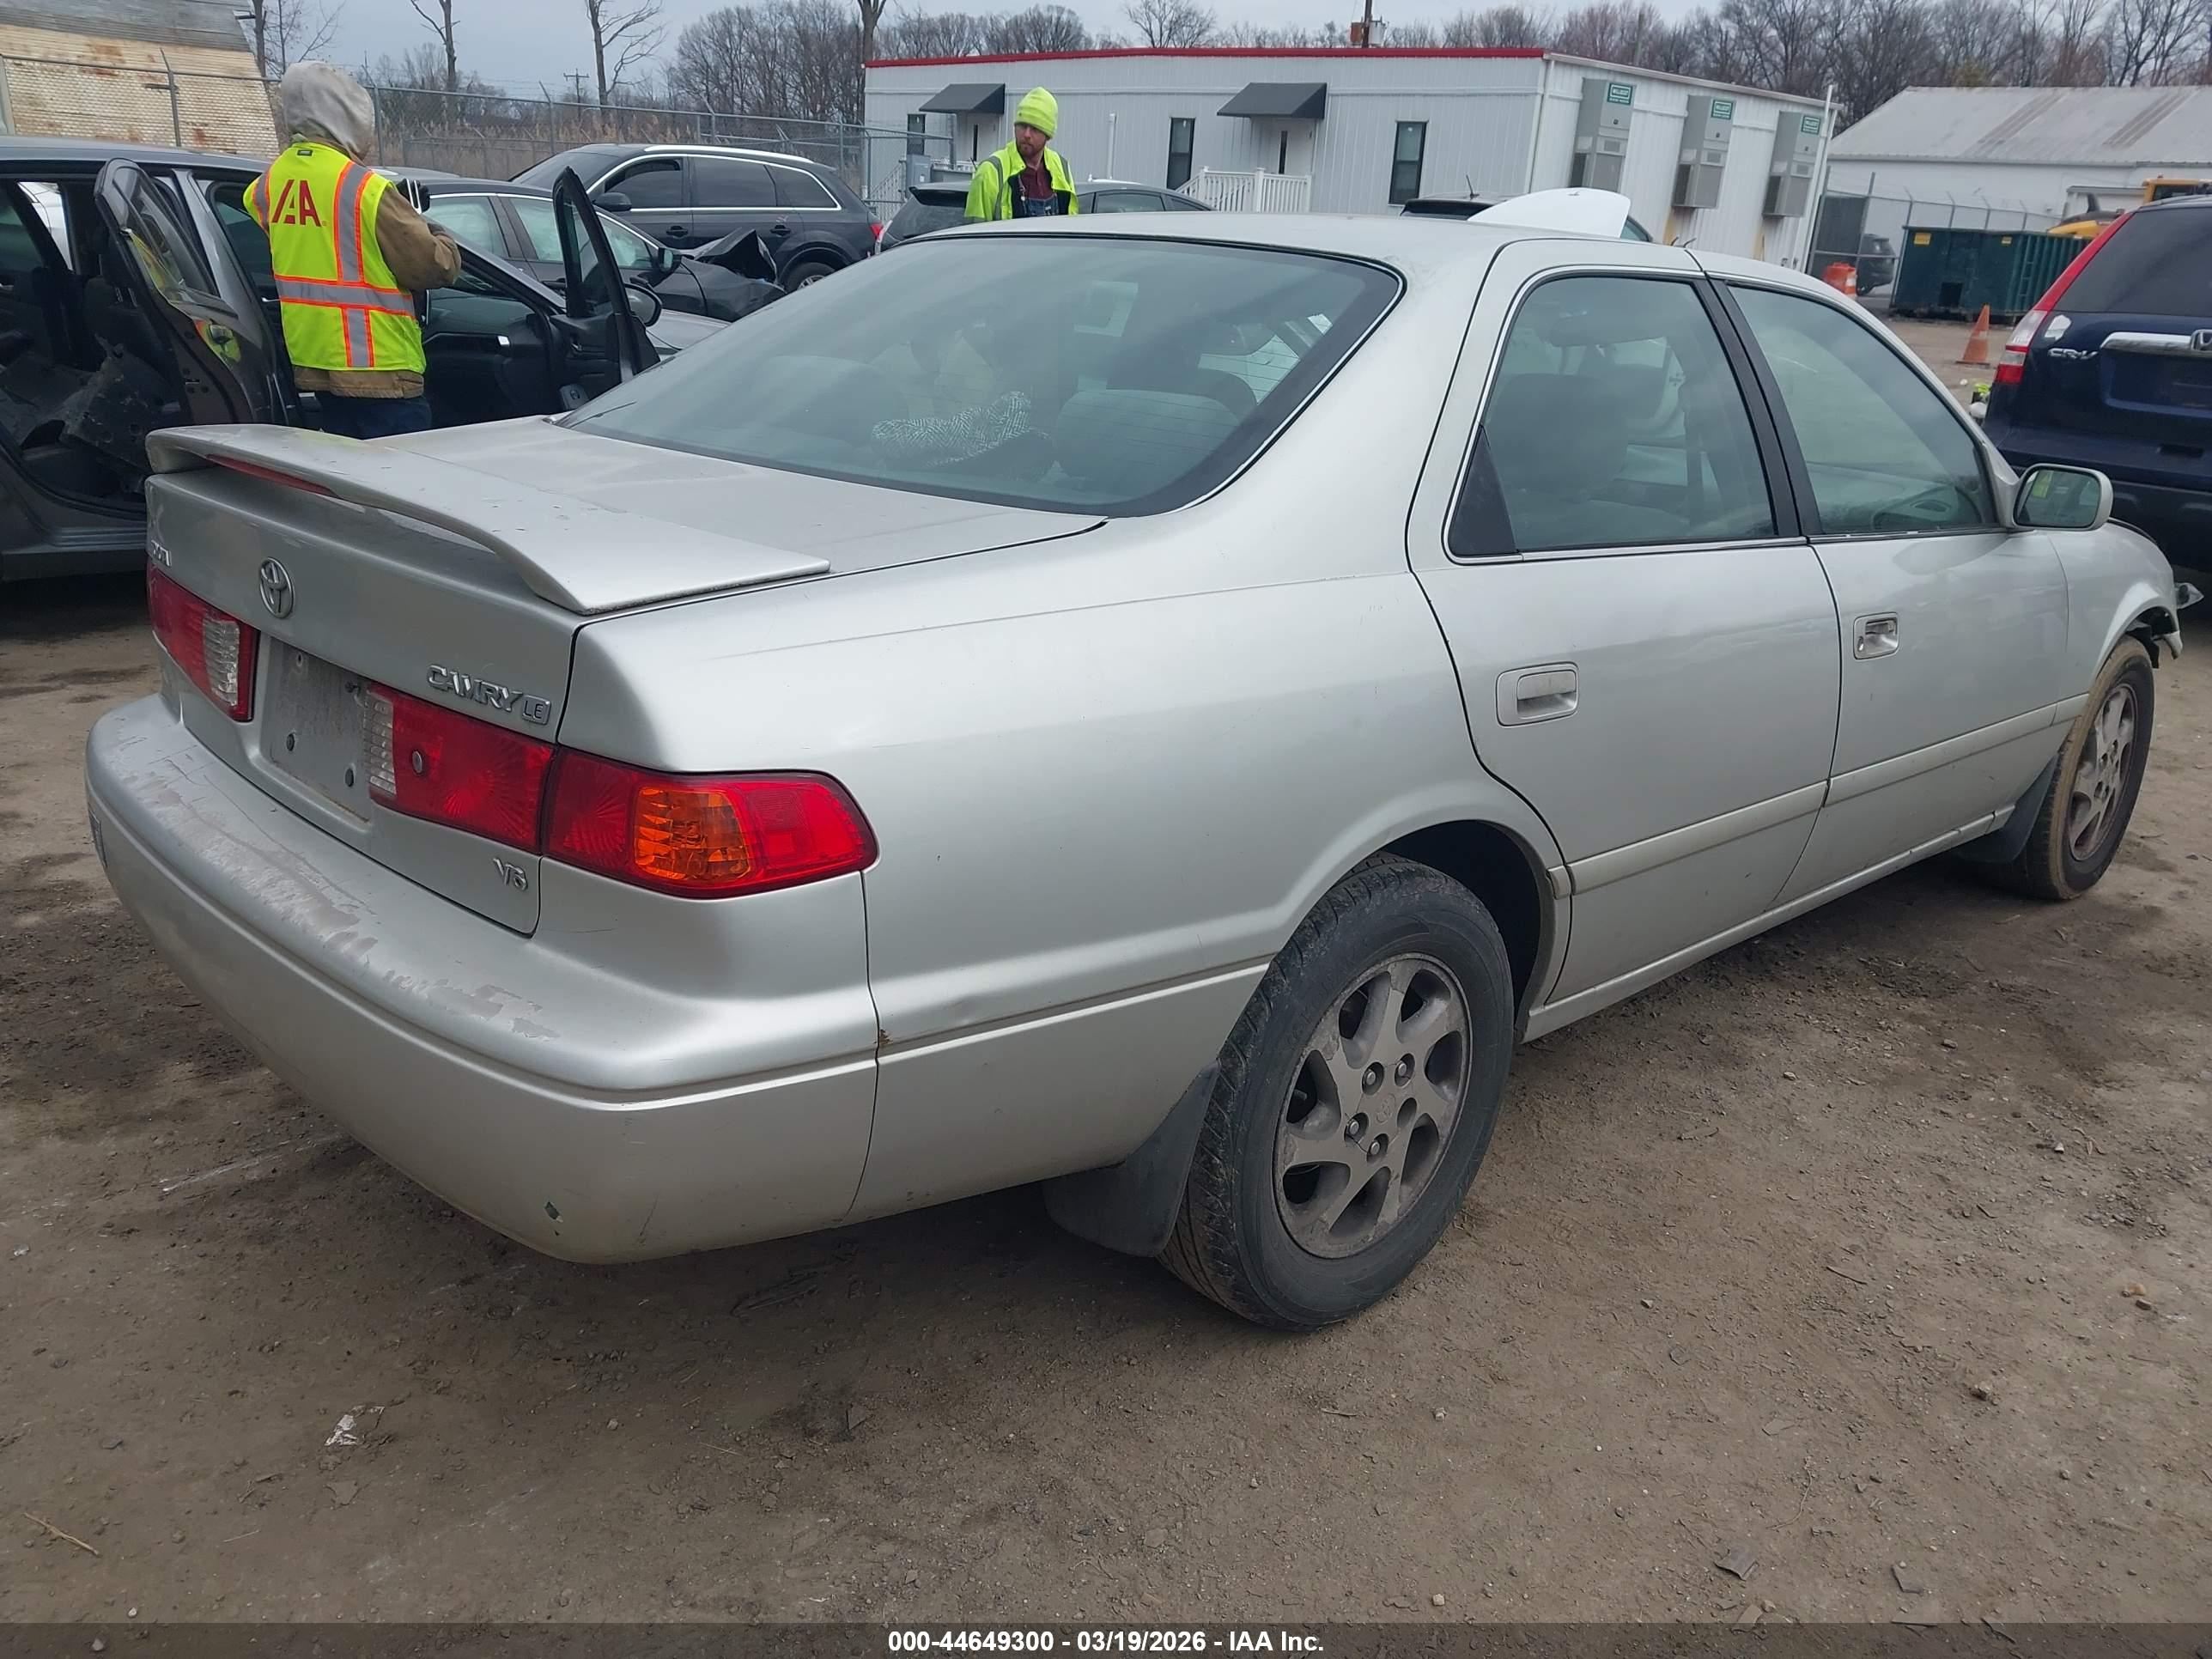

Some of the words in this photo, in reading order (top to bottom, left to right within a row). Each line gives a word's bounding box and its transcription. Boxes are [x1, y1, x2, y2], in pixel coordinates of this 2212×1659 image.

[428, 664, 523, 713] CAMRY
[523, 697, 547, 722] LE
[493, 858, 527, 890] V6
